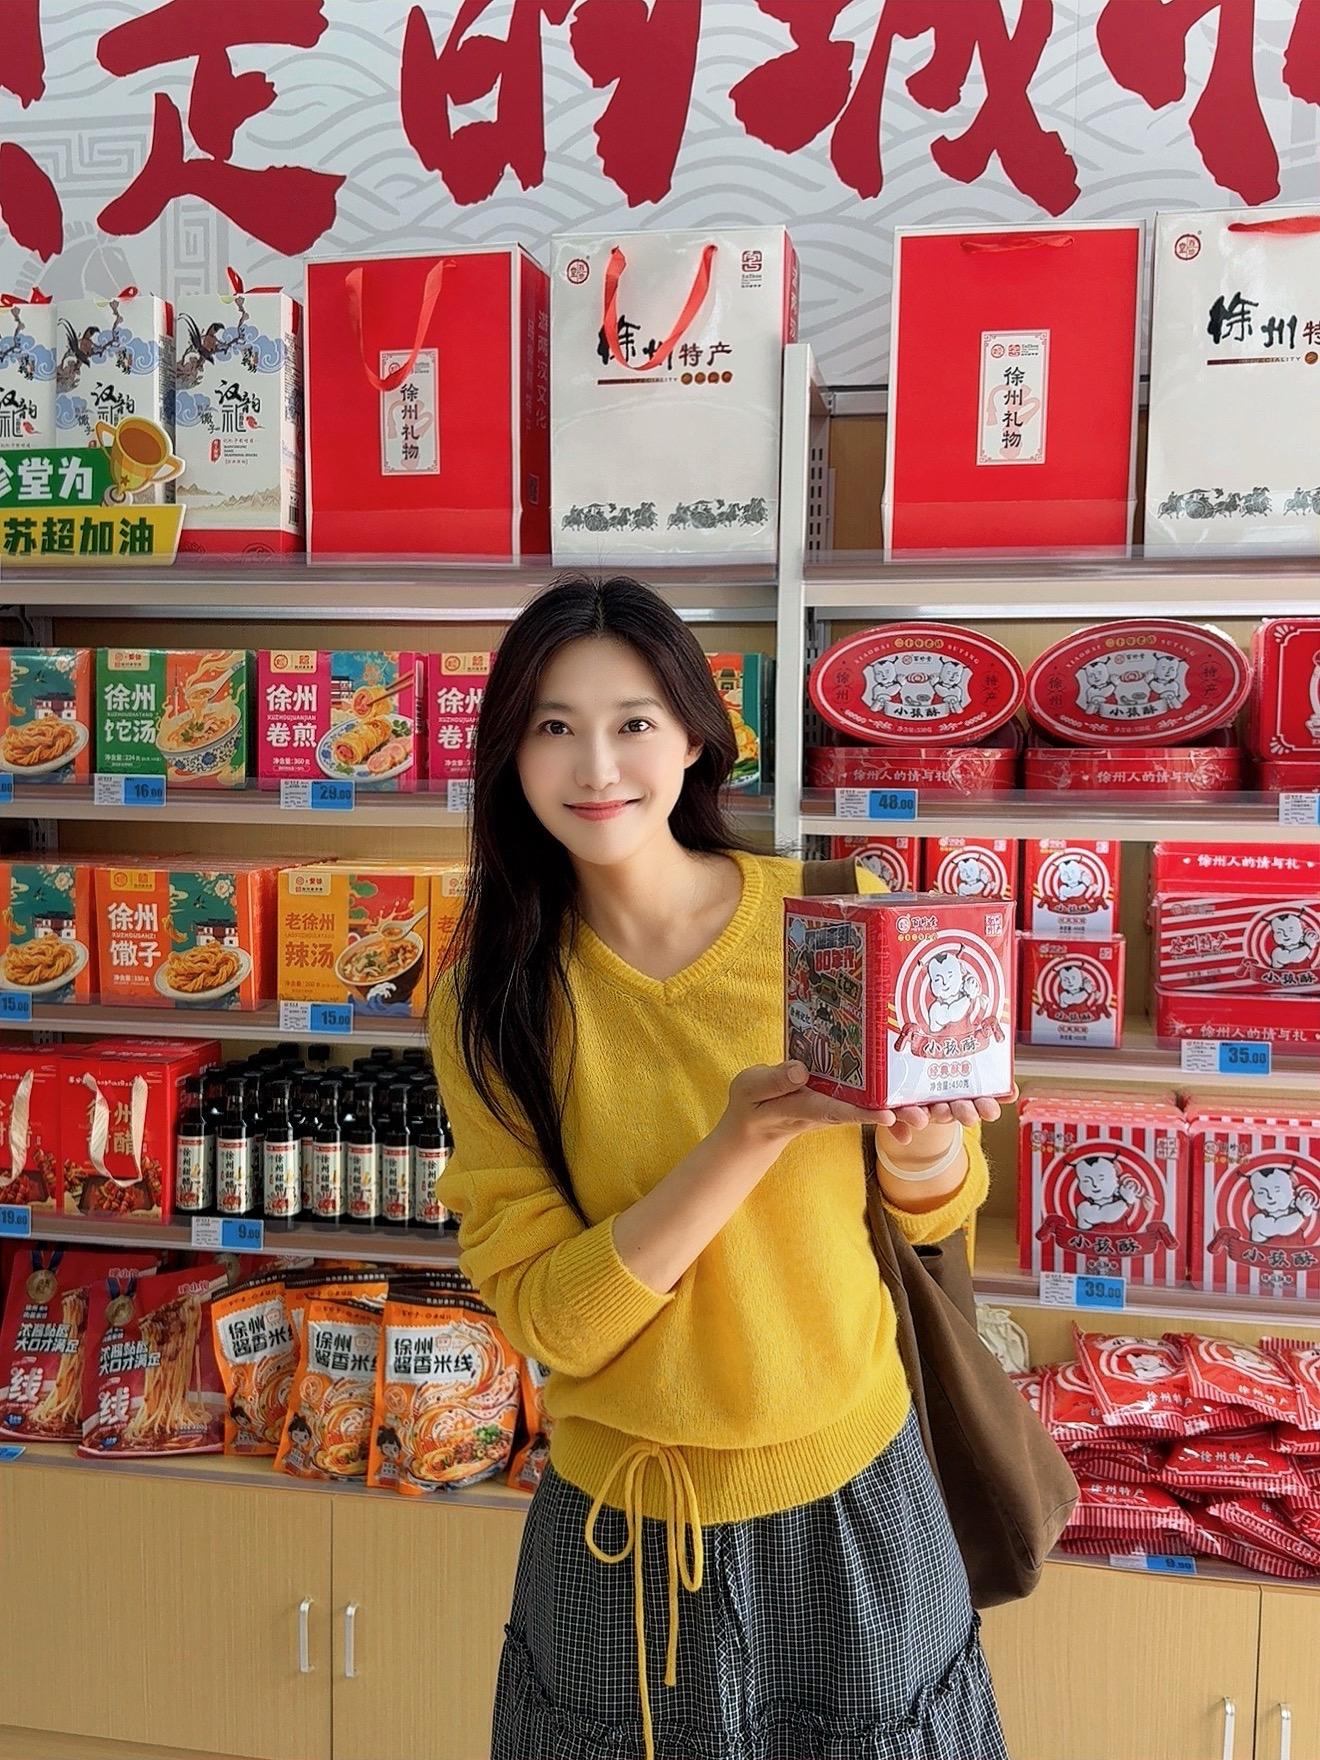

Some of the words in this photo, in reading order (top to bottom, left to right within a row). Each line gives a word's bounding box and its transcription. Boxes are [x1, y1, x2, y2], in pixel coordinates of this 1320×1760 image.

[1001, 366, 1026, 449] 徐州礼物
[400, 383, 420, 460] 徐州礼物
[3, 517, 154, 557] 苏超加油
[104, 683, 156, 711] 徐州
[265, 684, 318, 712] 徐州
[266, 722, 318, 748] 卷煎
[134, 784, 163, 798] 16.00
[320, 785, 352, 801] 29.00
[878, 794, 914, 810] 48.00
[107, 902, 159, 932] 徐州
[285, 912, 335, 931] 老徐州
[110, 940, 162, 967] 馓子
[285, 942, 335, 968] 辣汤
[321, 1010, 350, 1026] 15.00
[924, 1036, 980, 1055] 小孩酥
[1228, 1047, 1267, 1064] 35.00
[238, 1224, 261, 1240] 9.00
[1069, 1234, 1142, 1254] 小孩酥
[1242, 1247, 1318, 1268] 小孩酥
[1085, 1281, 1121, 1298] 39.00
[229, 1314, 266, 1340] 徐州
[232, 1325, 293, 1358] 酱香米
[316, 1331, 353, 1352] 徐州
[394, 1336, 433, 1355] 徐州
[314, 1348, 378, 1372] 酱香米
[394, 1353, 473, 1374] 酱香米线
[8, 1366, 44, 1403] 线
[98, 1386, 131, 1425] 线
